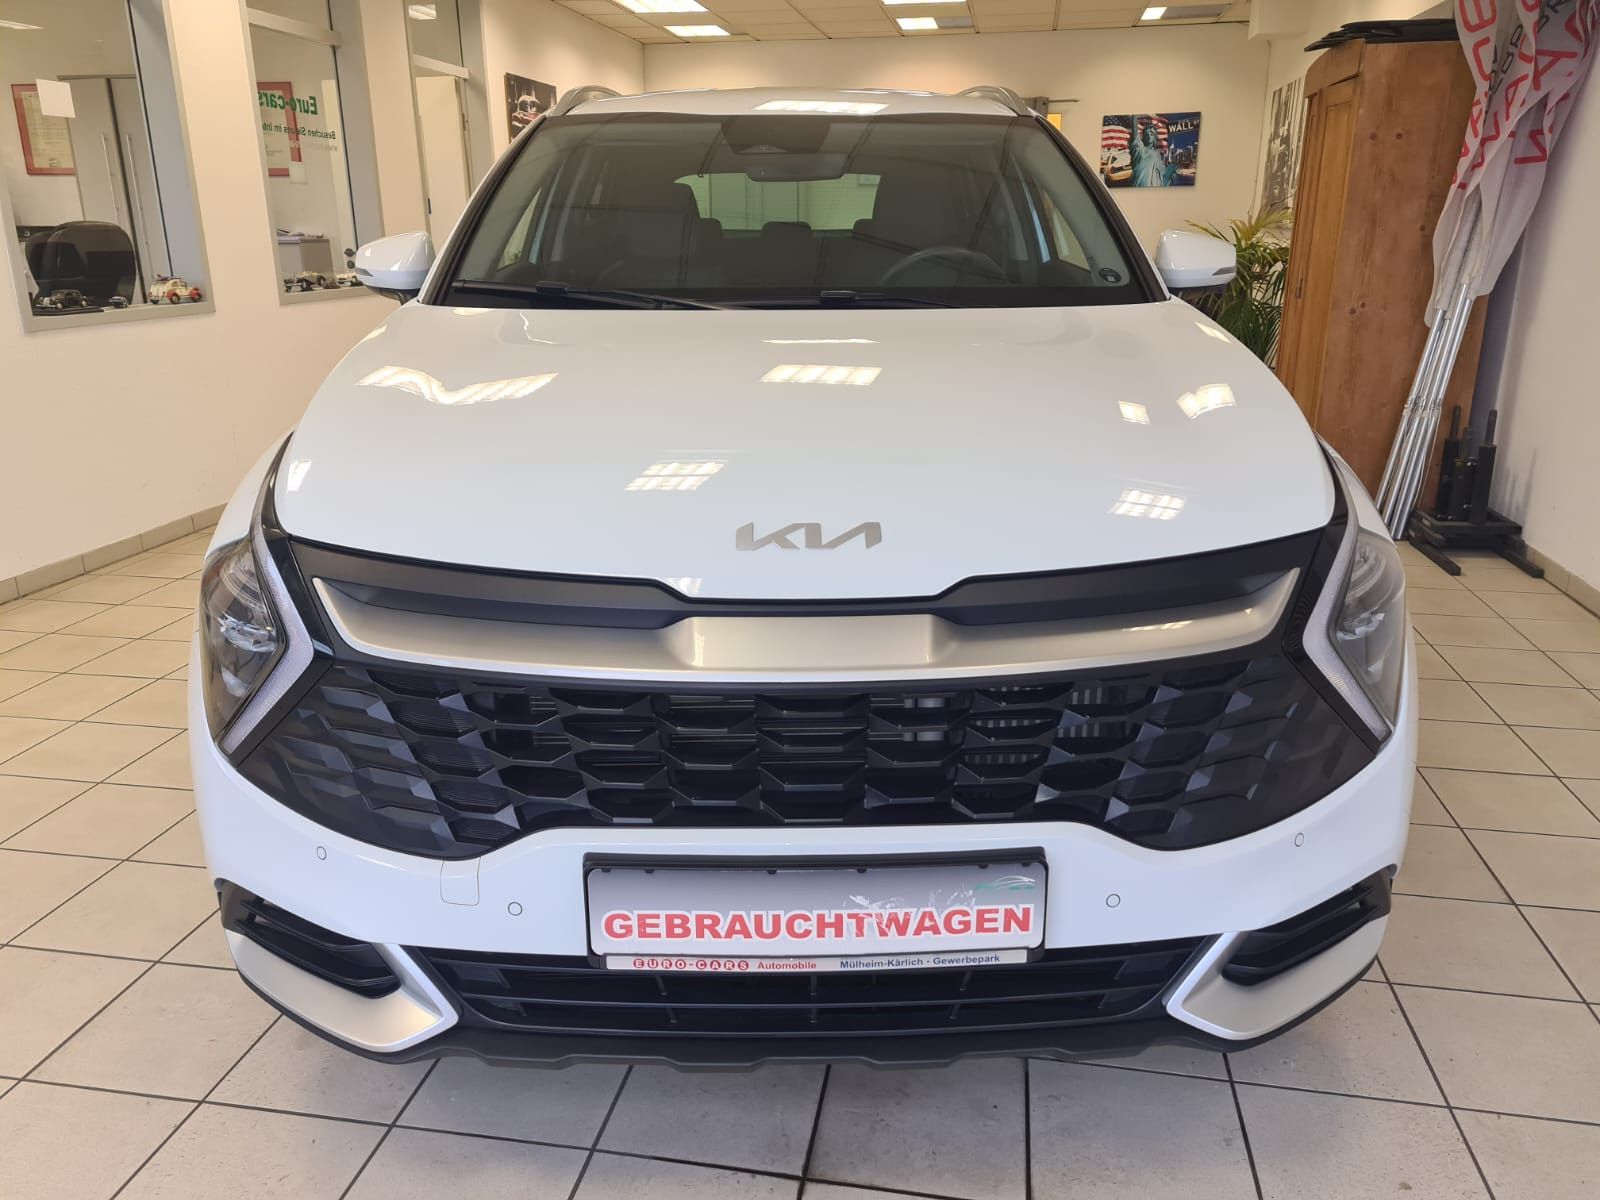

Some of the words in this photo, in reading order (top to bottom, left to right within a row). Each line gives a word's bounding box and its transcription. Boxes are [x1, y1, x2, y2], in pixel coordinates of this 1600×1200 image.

[1168, 122, 1193, 133] WALL
[604, 906, 1032, 940] GEBRAUCHTWAGEN
[633, 958, 749, 971] EURO-CARS
[757, 961, 816, 971] Automobile
[840, 957, 924, 970] Mülheim-Kärlich
[933, 953, 1000, 967] Gewerbepark
